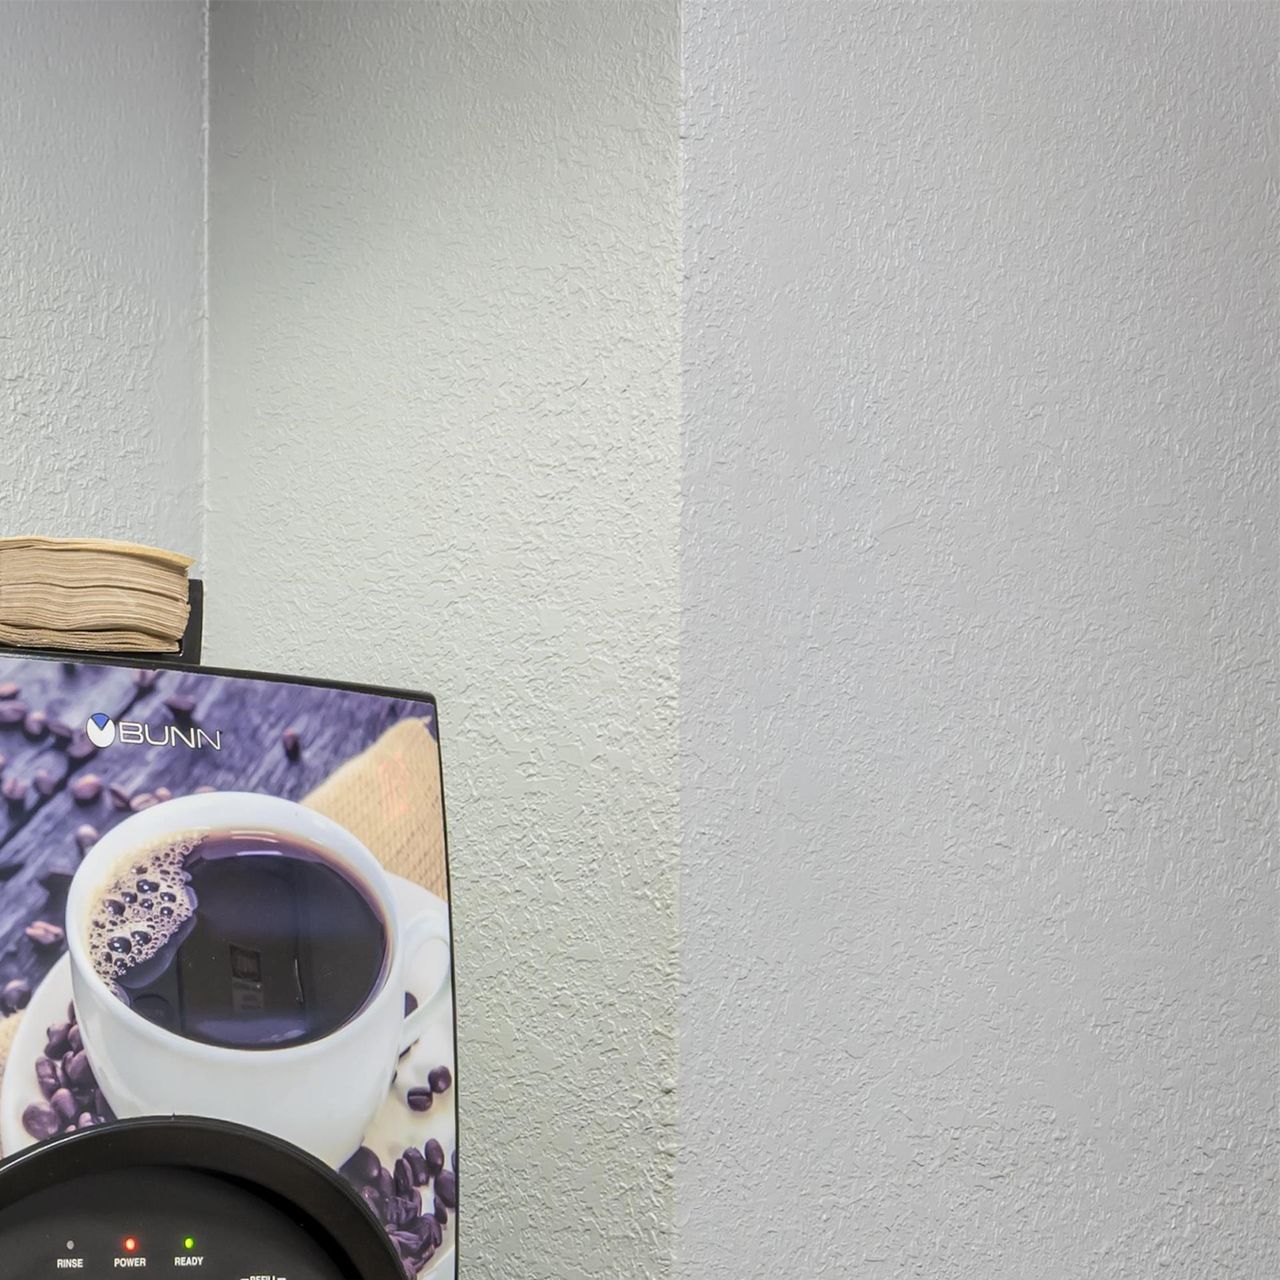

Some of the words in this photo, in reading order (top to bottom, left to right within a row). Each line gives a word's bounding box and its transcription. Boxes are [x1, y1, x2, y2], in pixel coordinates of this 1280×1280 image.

[118, 721, 222, 750] BUNN
[56, 1258, 84, 1269] RINSE
[113, 1257, 147, 1268] POWER
[174, 1256, 204, 1267] READY
